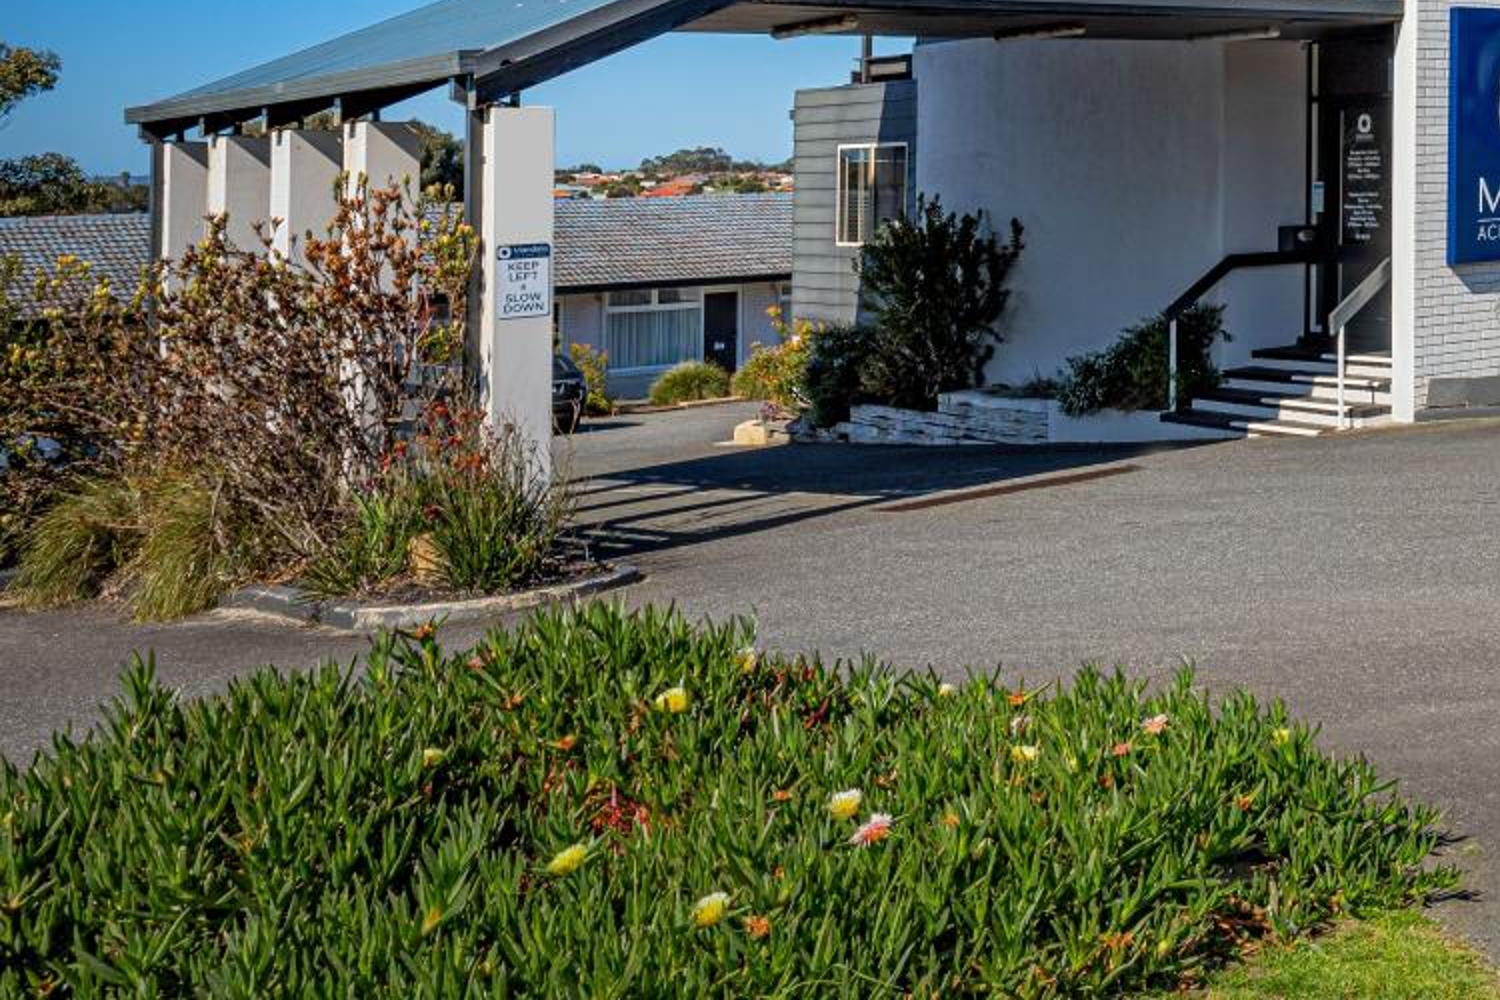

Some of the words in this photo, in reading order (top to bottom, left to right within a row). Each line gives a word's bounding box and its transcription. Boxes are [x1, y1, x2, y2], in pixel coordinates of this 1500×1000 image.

[507, 261, 539, 270] KEEP
[509, 271, 538, 282] LEFT
[506, 293, 541, 302] SLOW
[503, 302, 544, 313] DOWN
